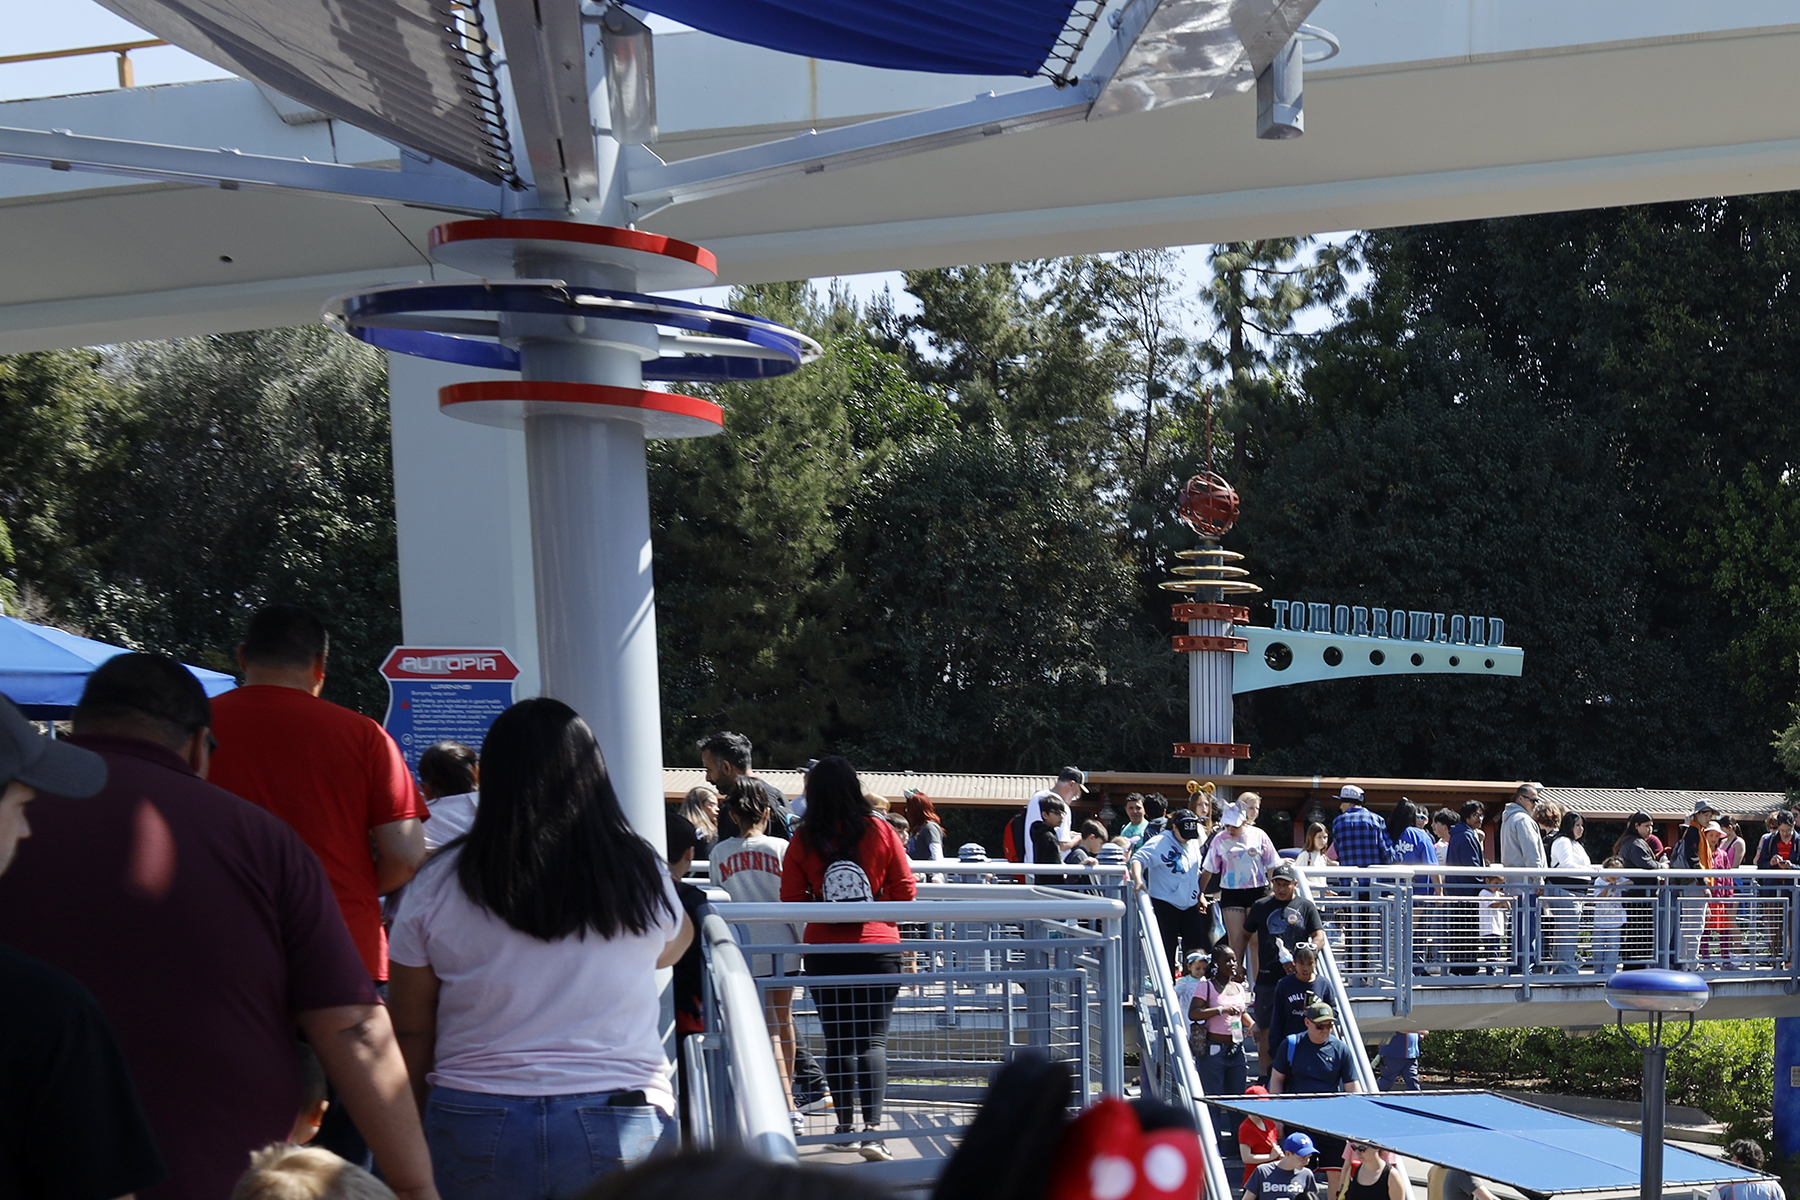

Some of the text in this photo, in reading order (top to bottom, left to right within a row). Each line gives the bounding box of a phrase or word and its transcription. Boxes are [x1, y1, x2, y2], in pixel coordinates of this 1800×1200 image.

[1272, 599, 1505, 646] TOMORROWLAND
[402, 656, 497, 671] AUTOPIA
[719, 851, 781, 882] MINNIE
[1288, 992, 1322, 1003] HOLLER
